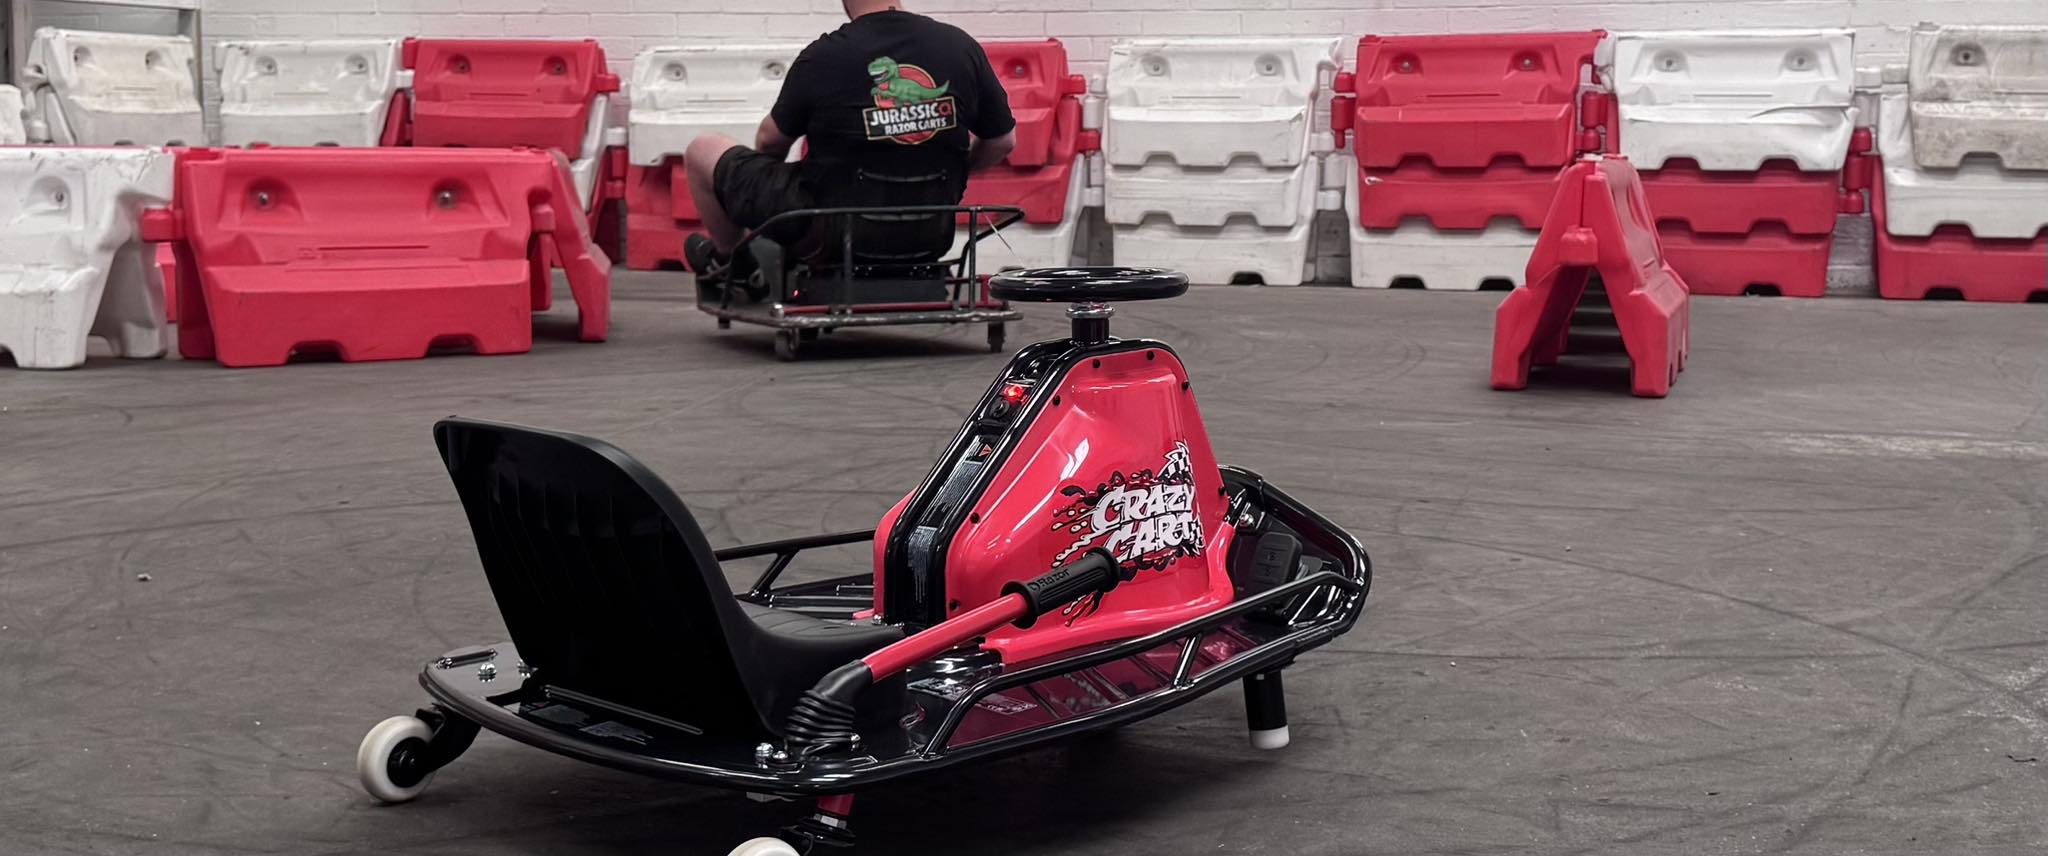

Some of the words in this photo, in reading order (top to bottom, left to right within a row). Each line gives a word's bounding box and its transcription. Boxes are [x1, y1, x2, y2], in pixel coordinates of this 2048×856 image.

[884, 122, 917, 135] RAZOR
[918, 117, 947, 130] CARTS
[1091, 483, 1195, 532] CRAZY
[1104, 511, 1193, 564] CART
[1039, 568, 1070, 587] Razor
